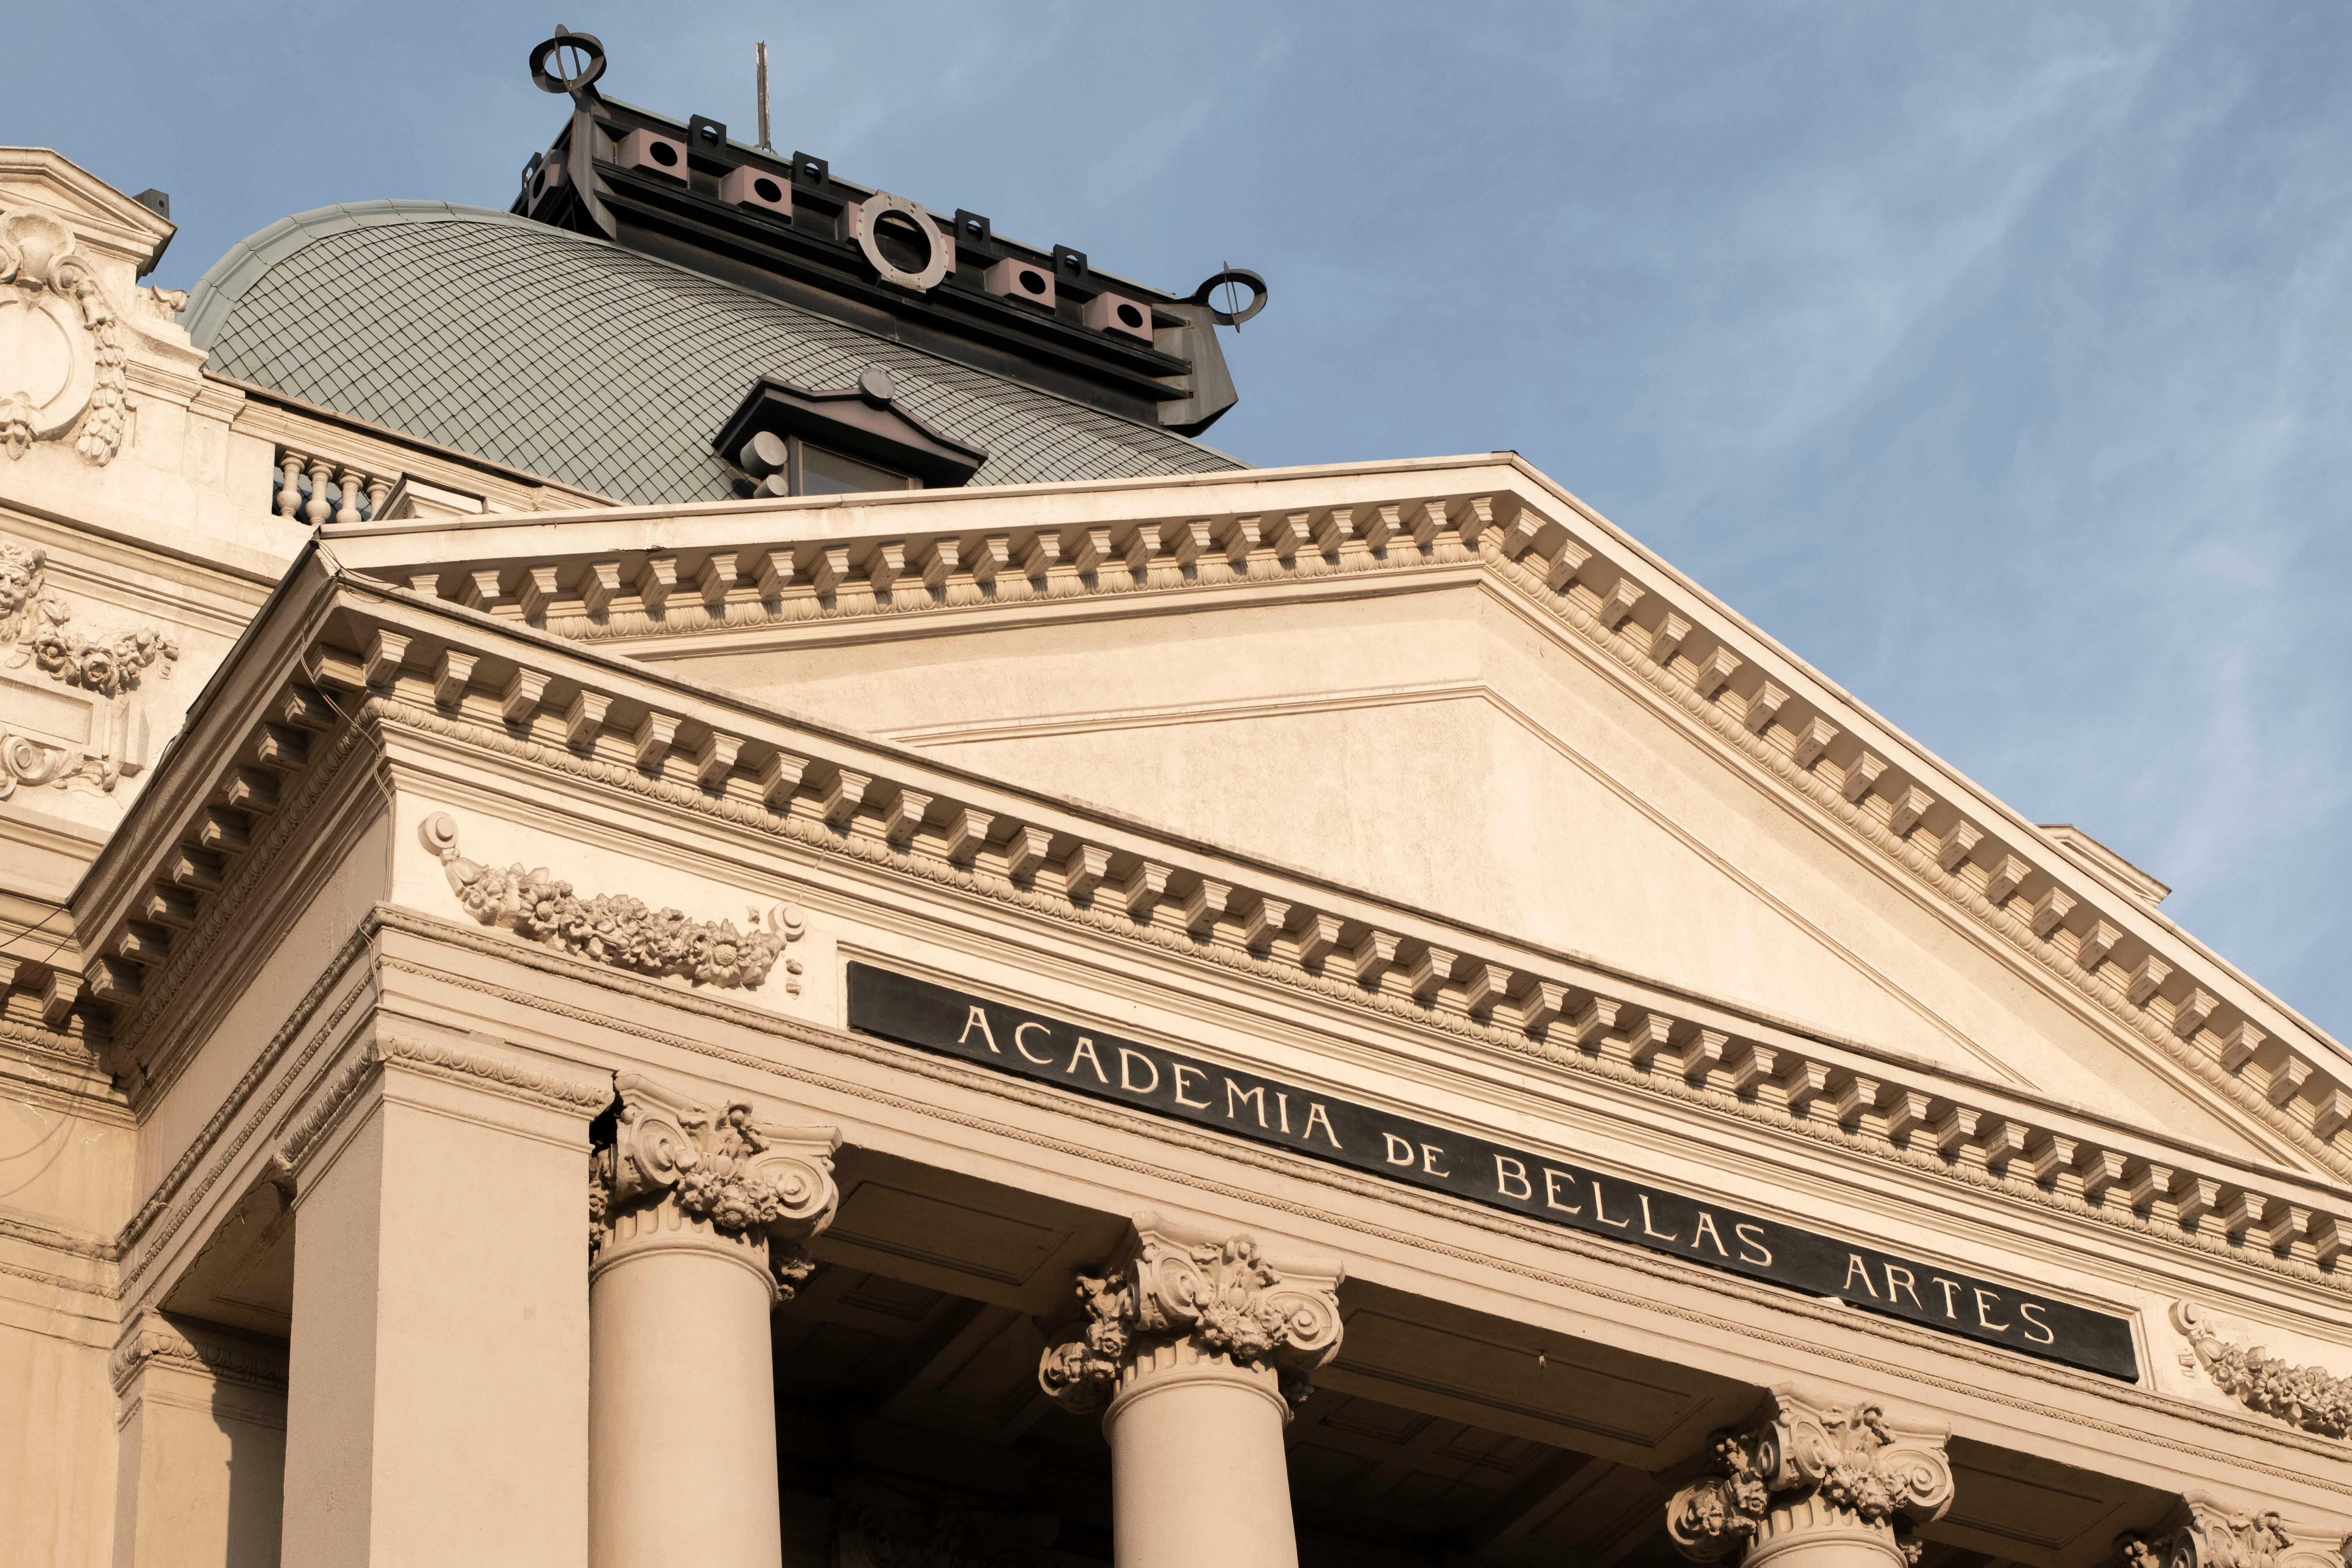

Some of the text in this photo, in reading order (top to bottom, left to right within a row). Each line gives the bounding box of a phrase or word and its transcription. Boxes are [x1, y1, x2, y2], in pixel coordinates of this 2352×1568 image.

[957, 1005, 2054, 1345] ACADEMIA DE BELLAS ARTES
